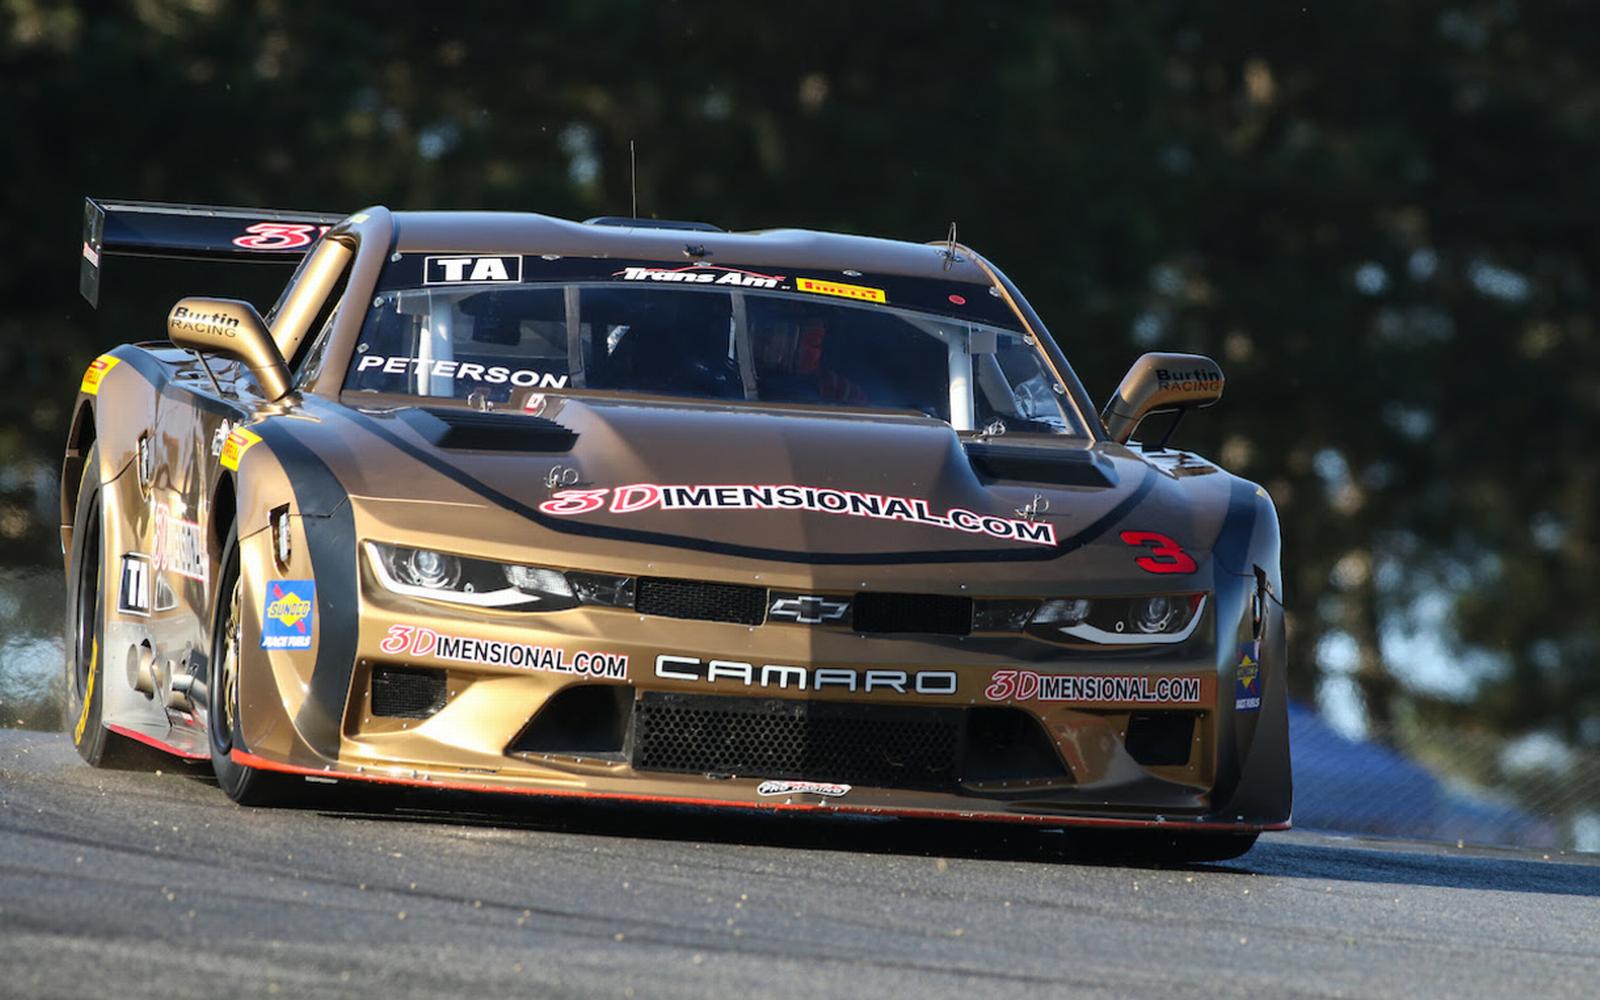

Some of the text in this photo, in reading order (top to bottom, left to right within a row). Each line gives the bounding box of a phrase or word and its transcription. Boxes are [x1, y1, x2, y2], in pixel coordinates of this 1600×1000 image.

[437, 258, 509, 281] TA
[624, 267, 778, 289] Trans Am
[174, 306, 240, 328] Burtin
[171, 319, 237, 338] RACING
[357, 355, 568, 389] PETERSON
[1156, 369, 1220, 381] Burtin
[1158, 380, 1220, 392] RACING
[1120, 530, 1199, 575] 3
[268, 602, 310, 616] SUNOCO
[654, 654, 958, 695] CAMARO
